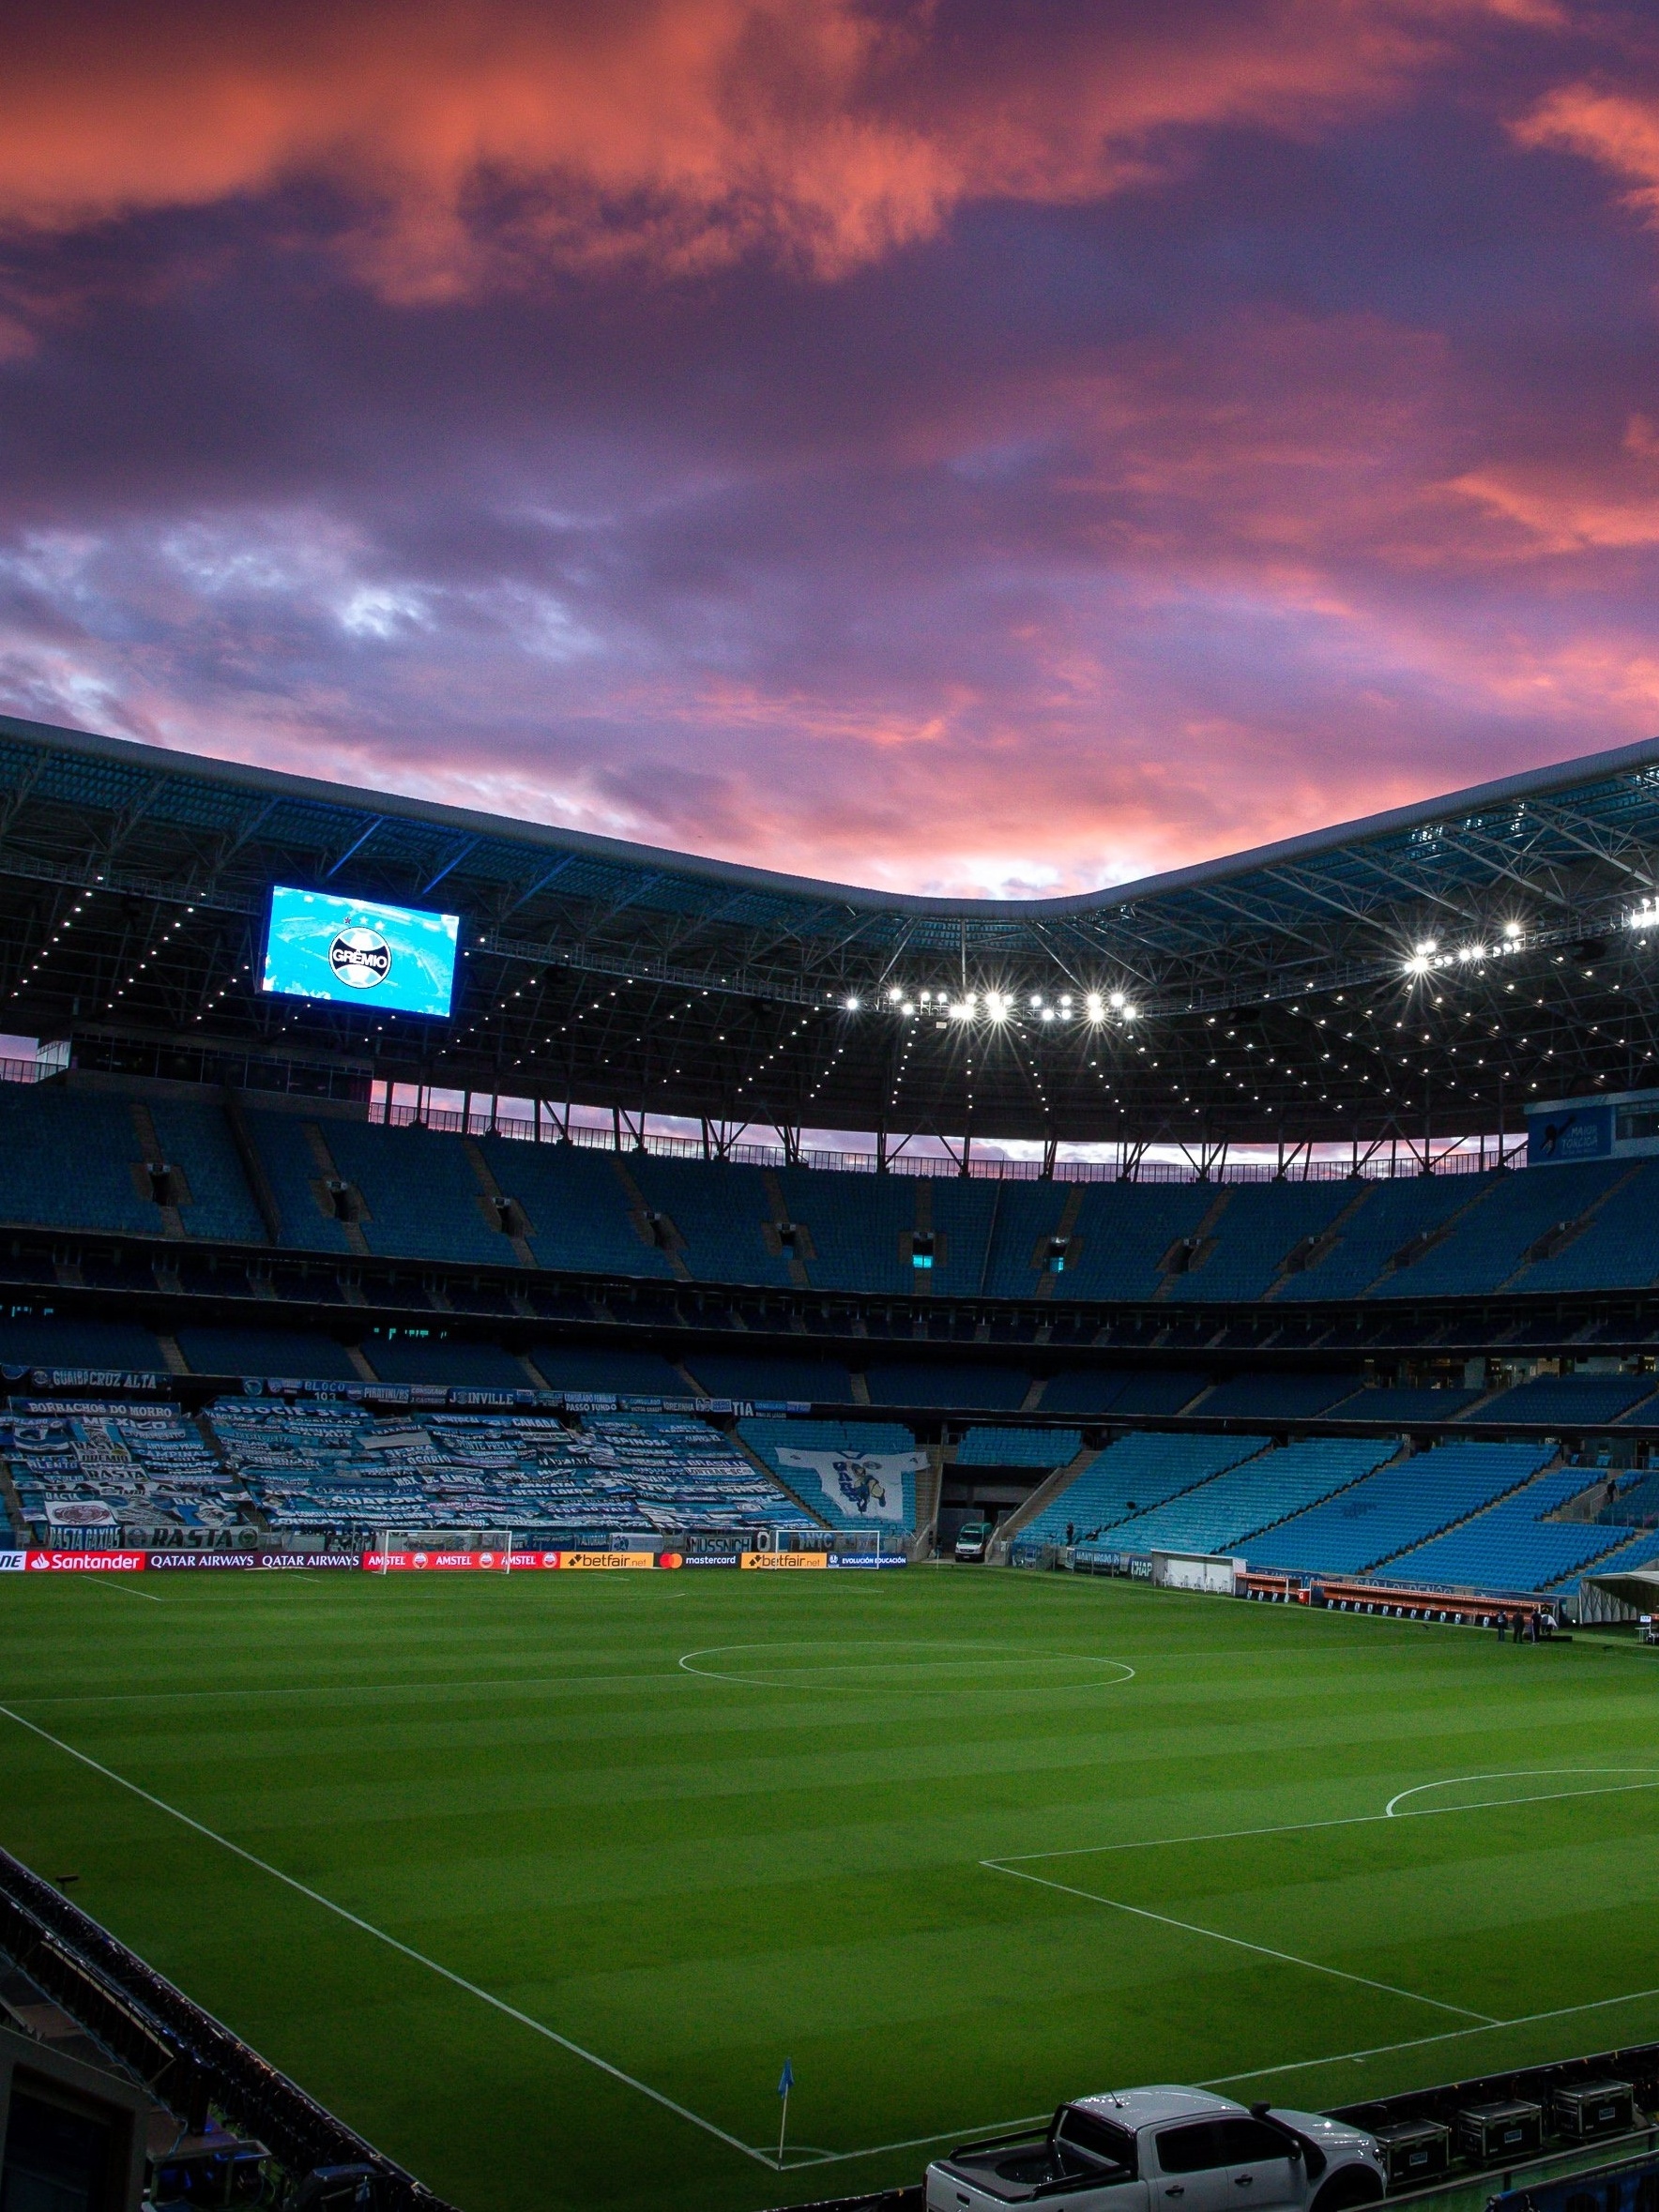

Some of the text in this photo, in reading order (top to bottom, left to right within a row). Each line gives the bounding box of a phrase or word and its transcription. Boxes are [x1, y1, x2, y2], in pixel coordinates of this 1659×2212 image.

[333, 949, 387, 968] GRÊMIO
[89, 1372, 157, 1388] CRUZ ALTA
[304, 1382, 345, 1391] BLOCO
[314, 1392, 336, 1401] 103
[28, 1403, 172, 1418] BORRACHOS DO MORRO
[566, 1403, 589, 1412] PASSO
[733, 1401, 753, 1417] TIA
[88, 1470, 147, 1479] RASTA
[152, 1527, 234, 1547] RASTA
[691, 1538, 750, 1552] MUSSNICH
[52, 1554, 141, 1569] Santander
[150, 1555, 254, 1568] QATAR AIRWAYS
[262, 1555, 359, 1568] QATAR AIRWAYS
[368, 1555, 406, 1566] AMSTEL
[435, 1555, 472, 1566] AMSTEL
[500, 1555, 536, 1565] AMSTEL
[583, 1554, 647, 1568] betfair.net
[685, 1555, 737, 1565] mastercard
[762, 1554, 820, 1568] betfair.net
[841, 1555, 907, 1565] EVOLUCIÓN EDUCACIÓN
